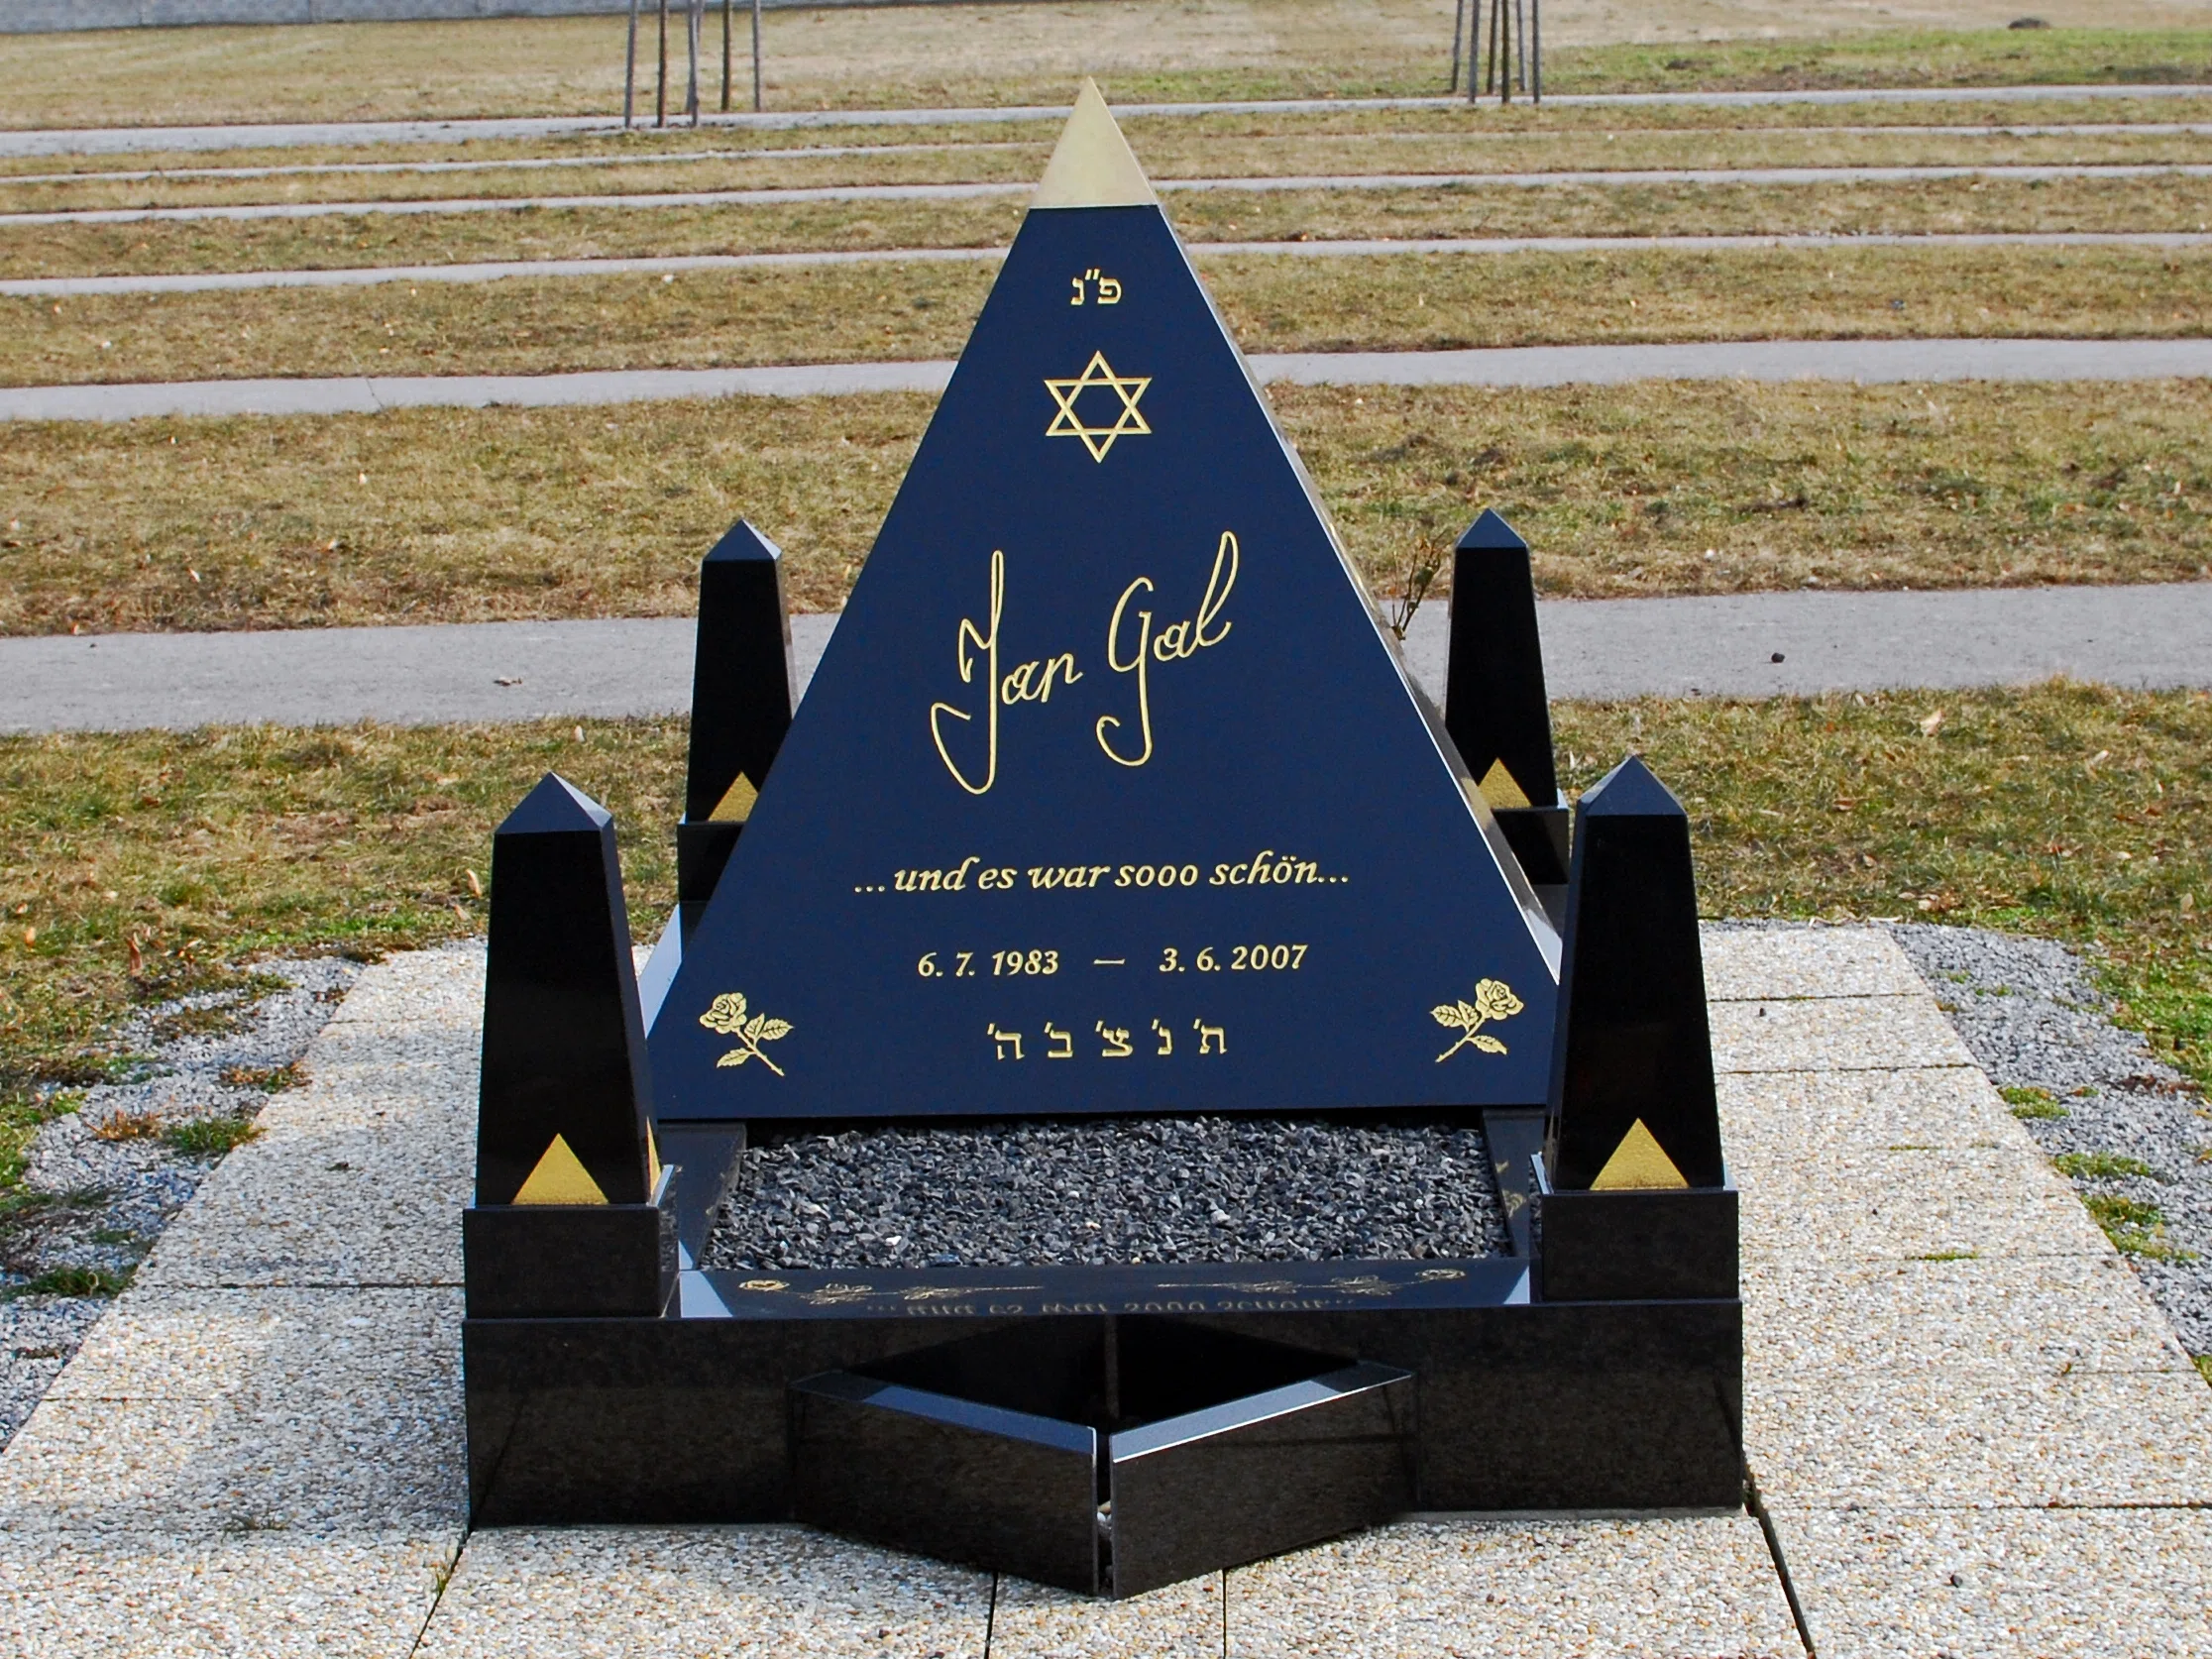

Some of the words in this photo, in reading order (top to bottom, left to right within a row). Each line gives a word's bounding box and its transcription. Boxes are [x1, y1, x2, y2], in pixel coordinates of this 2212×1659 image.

[930, 549, 1084, 795] Jan
[1095, 530, 1239, 767] Gal
[978, 868, 1018, 890] es
[1027, 865, 1112, 890] war
[1114, 864, 1199, 887] sooo
[991, 948, 1058, 976] 1983
[1230, 943, 1308, 970] 2007
